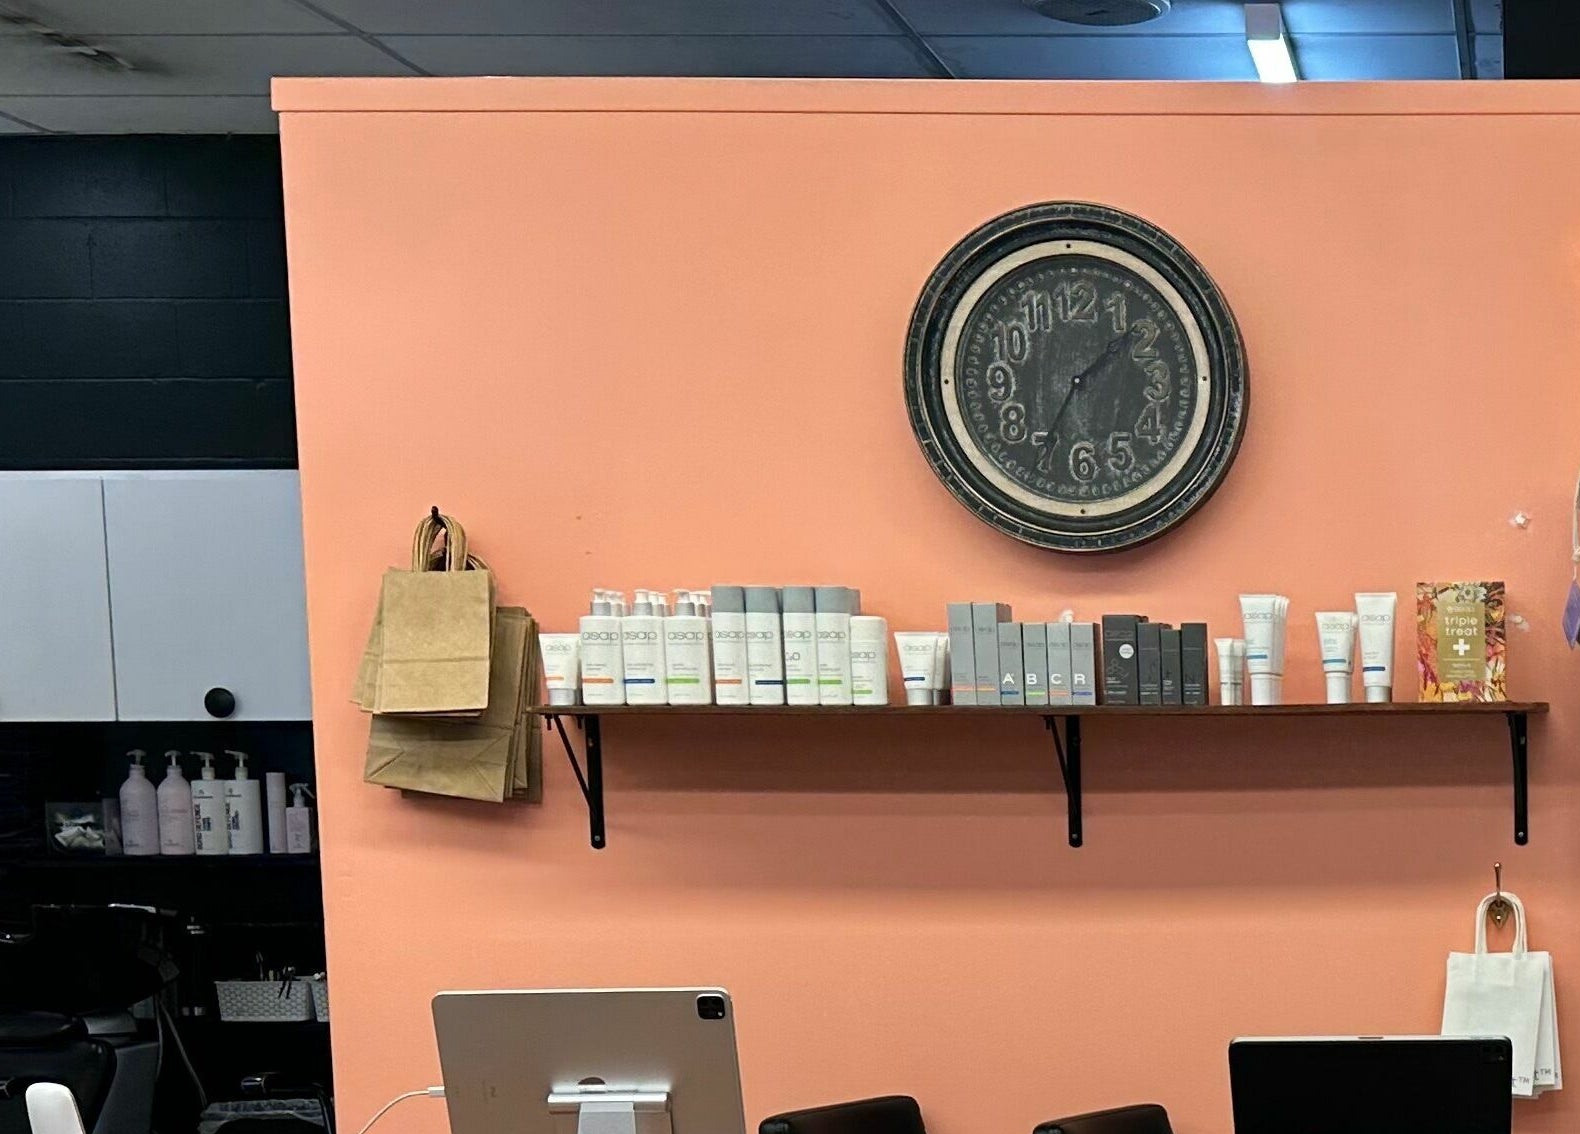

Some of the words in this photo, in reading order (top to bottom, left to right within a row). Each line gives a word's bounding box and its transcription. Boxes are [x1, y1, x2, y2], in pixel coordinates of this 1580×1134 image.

[1021, 289, 1054, 334] 11
[1054, 280, 1098, 322] 12
[1105, 290, 1127, 333] 1
[993, 320, 1030, 364] 10
[1131, 318, 1161, 360] 2
[986, 361, 1016, 402] 9
[1143, 361, 1171, 402] 3
[1001, 402, 1028, 443] 8
[1134, 400, 1165, 444] 4
[1068, 440, 1101, 482] 6
[1107, 431, 1135, 471] 5
[582, 631, 619, 644] asap
[667, 631, 704, 644] asap
[1444, 616, 1478, 627] triple
[1445, 627, 1478, 637] treat
[1026, 673, 1037, 685] B
[1050, 673, 1062, 685] C
[1074, 673, 1086, 685] R
